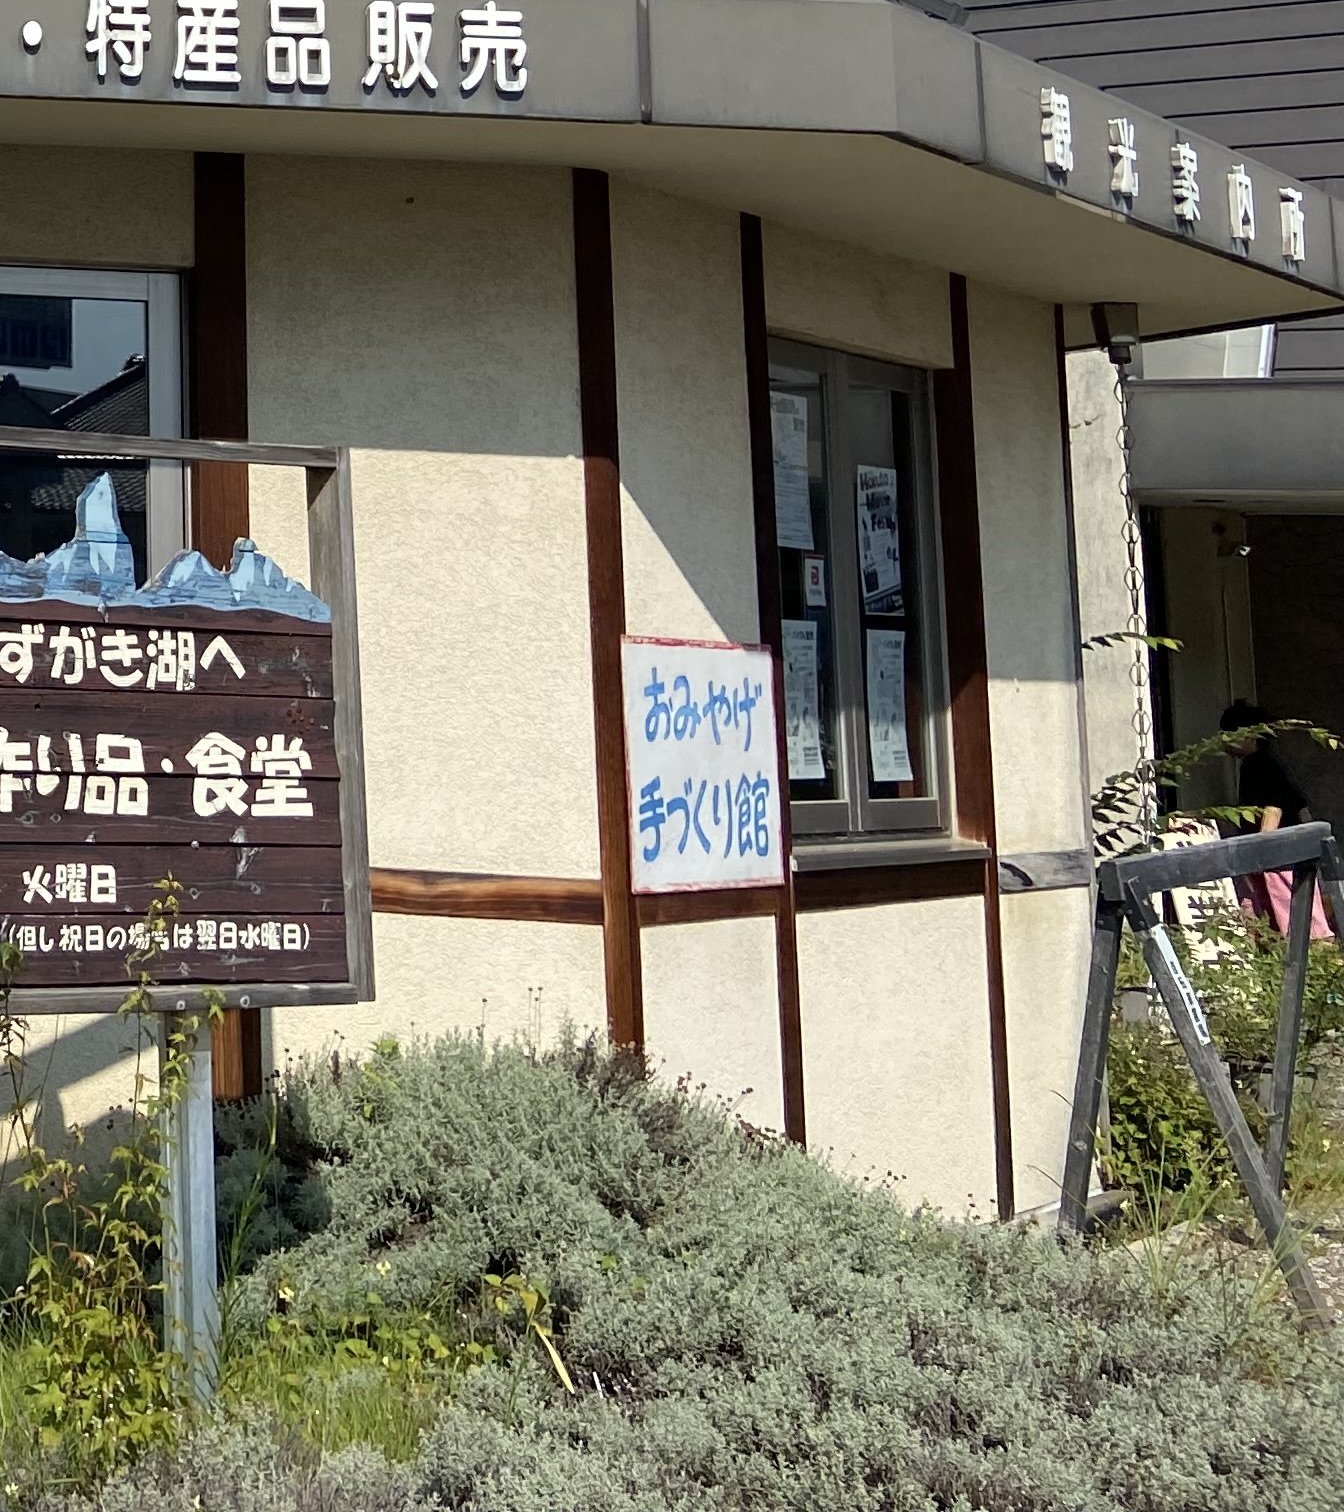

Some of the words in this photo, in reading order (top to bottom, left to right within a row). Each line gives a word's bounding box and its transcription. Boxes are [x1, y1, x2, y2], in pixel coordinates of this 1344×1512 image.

[1040, 86, 1306, 262] 観光案内所
[644, 666, 762, 752] おみやげ
[638, 771, 771, 864] 手づくり館
[22, 863, 118, 905] 火曜日
